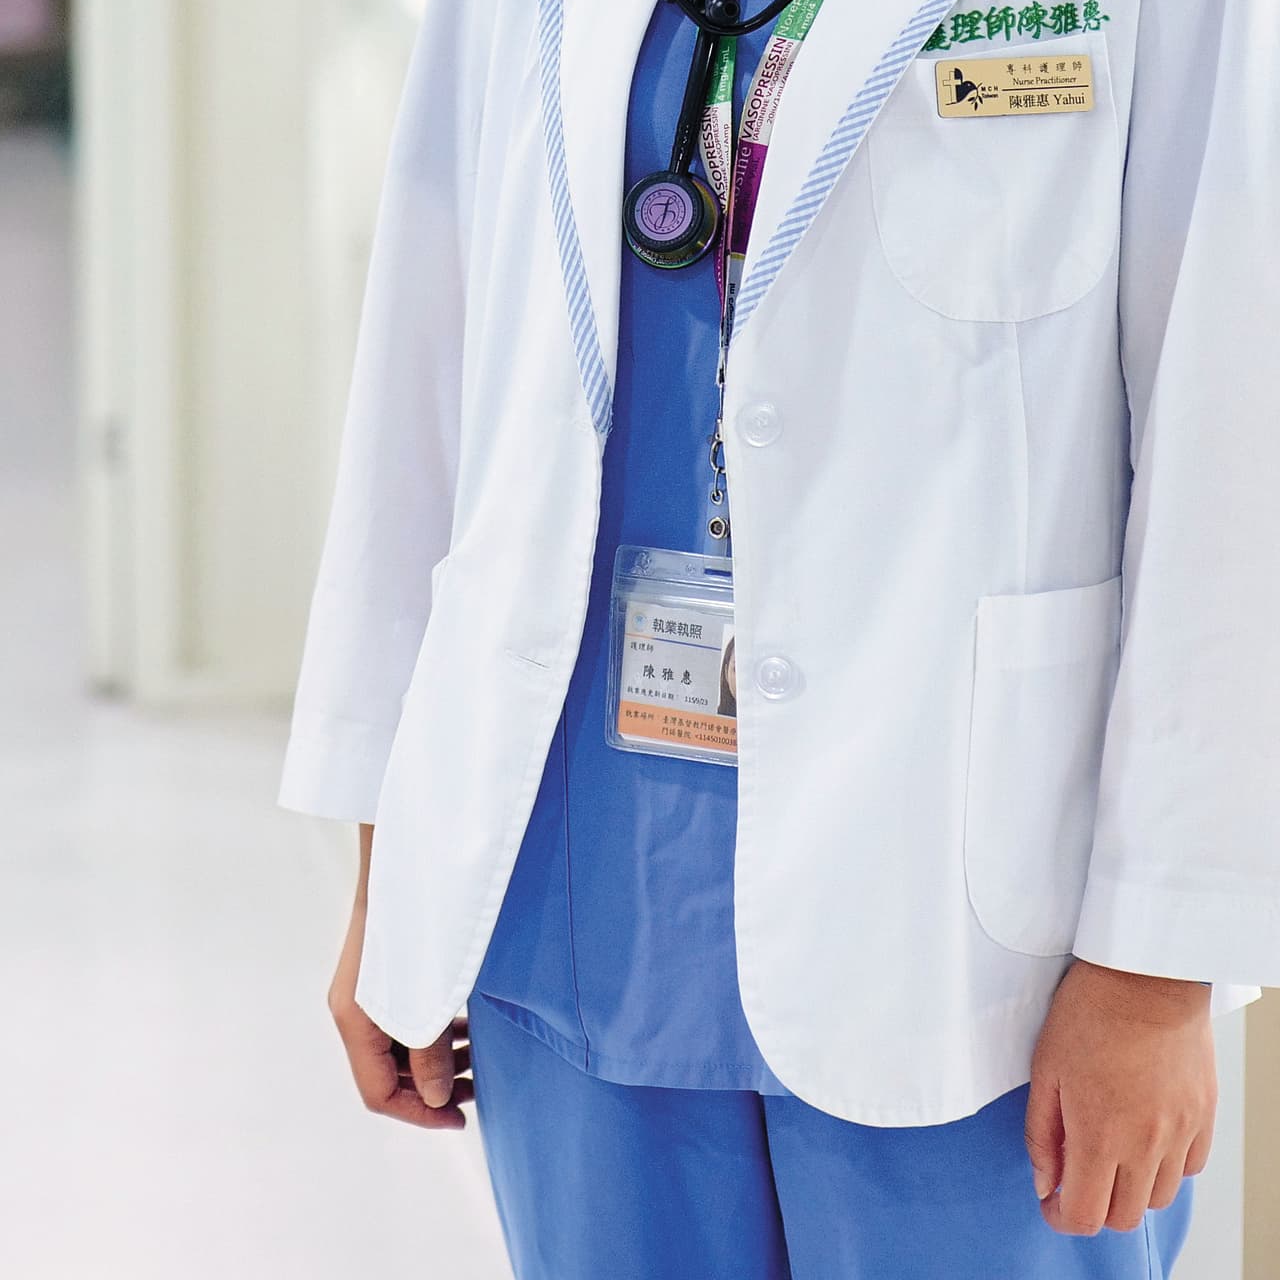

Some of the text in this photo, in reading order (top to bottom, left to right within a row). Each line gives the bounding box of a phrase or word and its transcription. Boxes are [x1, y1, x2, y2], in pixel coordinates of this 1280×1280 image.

[1006, 60, 1082, 75] 專科護理師
[741, 37, 787, 140] VASOPRESSIN
[1012, 76, 1077, 86] Nurse Practitioner
[1008, 92, 1085, 109] 陳雅惠 Yahui
[652, 618, 703, 639] 執業執照
[642, 664, 693, 685] 陳雅惠
